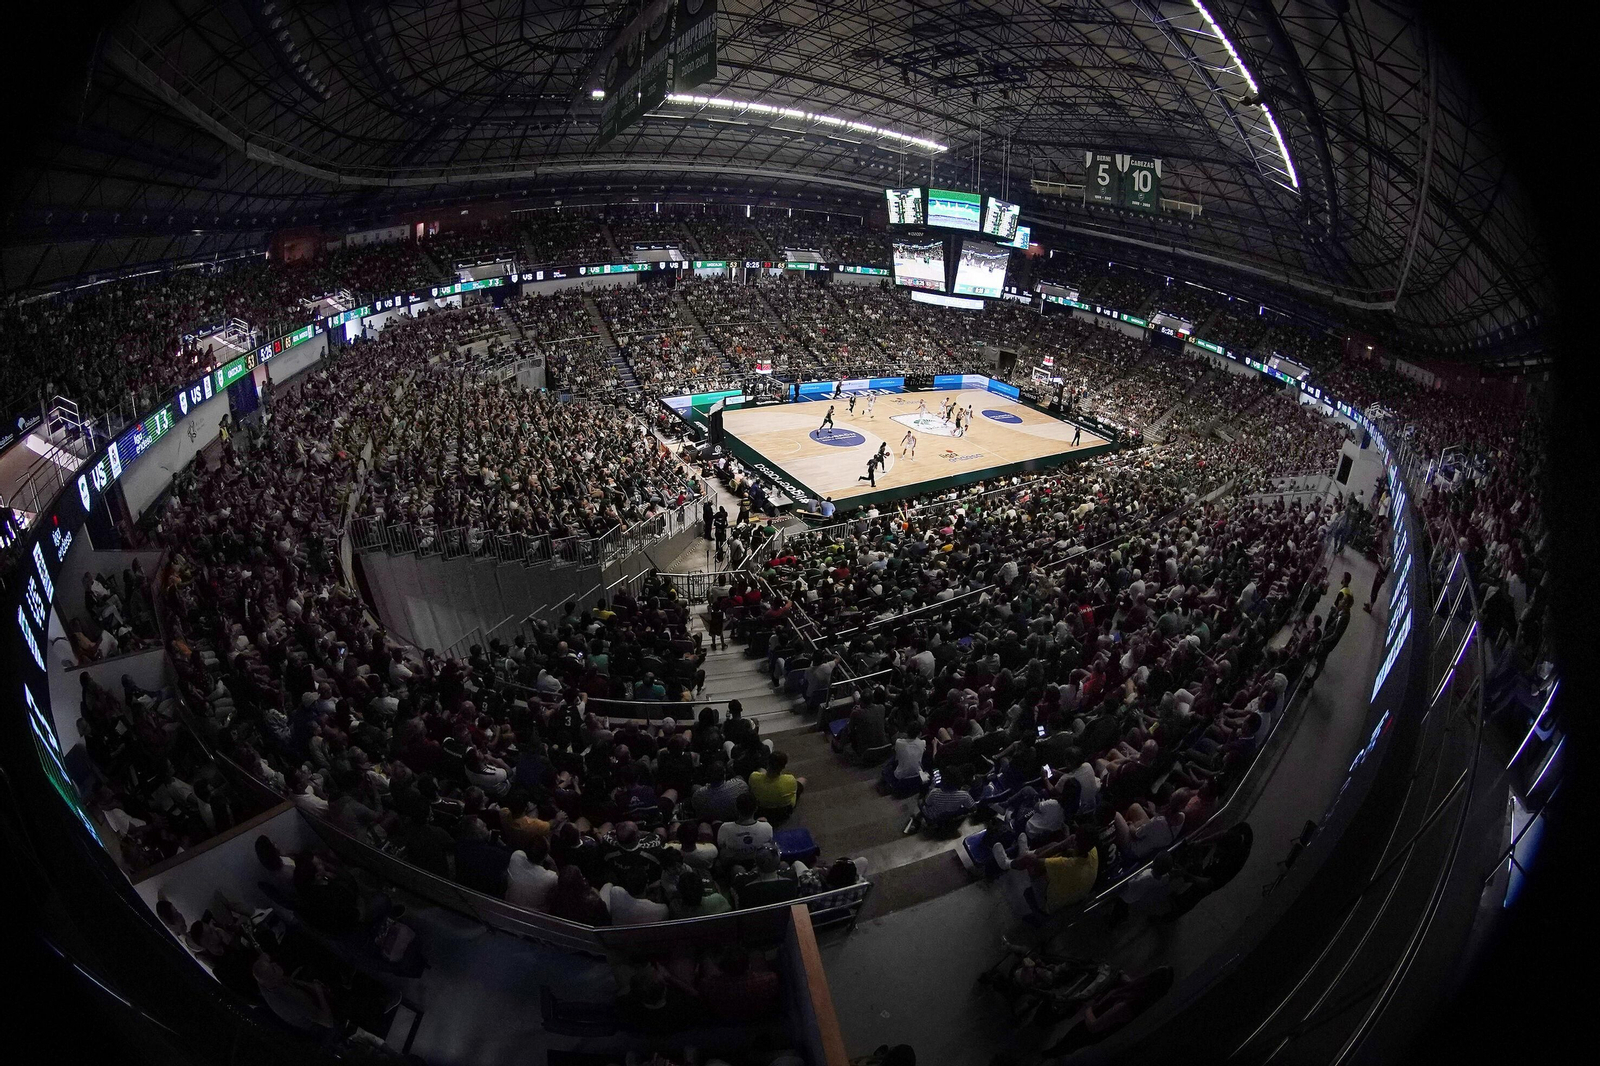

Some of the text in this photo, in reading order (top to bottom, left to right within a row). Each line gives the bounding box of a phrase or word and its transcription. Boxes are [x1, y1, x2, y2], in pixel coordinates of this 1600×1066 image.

[676, 12, 717, 54] CAMPEONES
[1130, 160, 1154, 168] CABEZAS
[1097, 164, 1110, 186] 5
[1132, 170, 1152, 192] 10
[384, 299, 392, 308] VS
[190, 385, 202, 404] VS
[154, 409, 168, 435] J 3
[134, 432, 142, 445] liga
[136, 436, 153, 454] endesa
[91, 461, 107, 492] VS
[753, 463, 810, 504] #ligaendesa
[564, 716, 572, 727] 3
